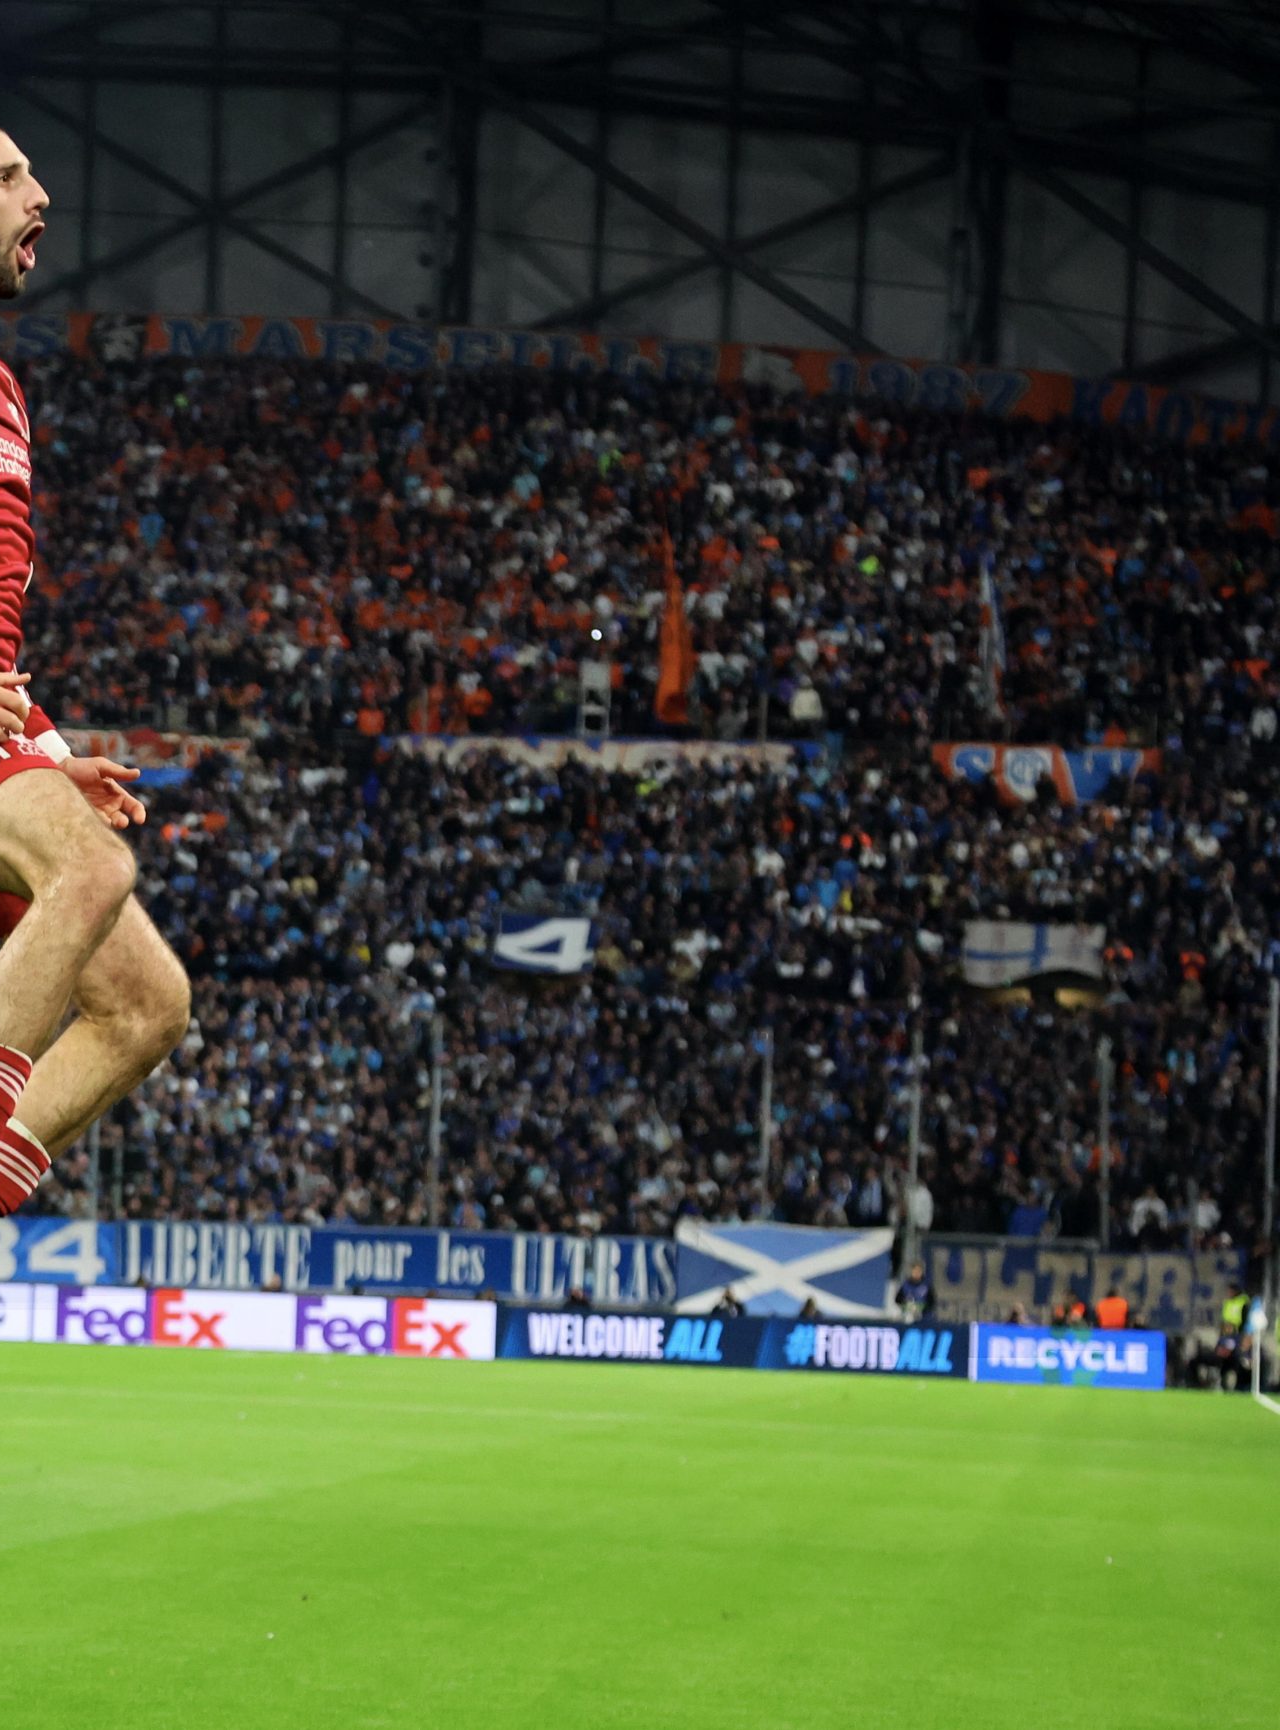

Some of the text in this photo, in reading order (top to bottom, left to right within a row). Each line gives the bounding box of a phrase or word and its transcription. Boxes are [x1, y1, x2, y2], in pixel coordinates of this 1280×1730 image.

[332, 1239, 413, 1291] pour
[437, 1232, 485, 1286] les
[511, 1233, 678, 1304] ULTRAS
[57, 1287, 227, 1348] FedEx
[295, 1297, 470, 1358] FedEx
[528, 1313, 723, 1363] WELCOME ALL
[783, 1323, 954, 1373] #FOOTBALL
[987, 1335, 1149, 1374] RECYCLE
